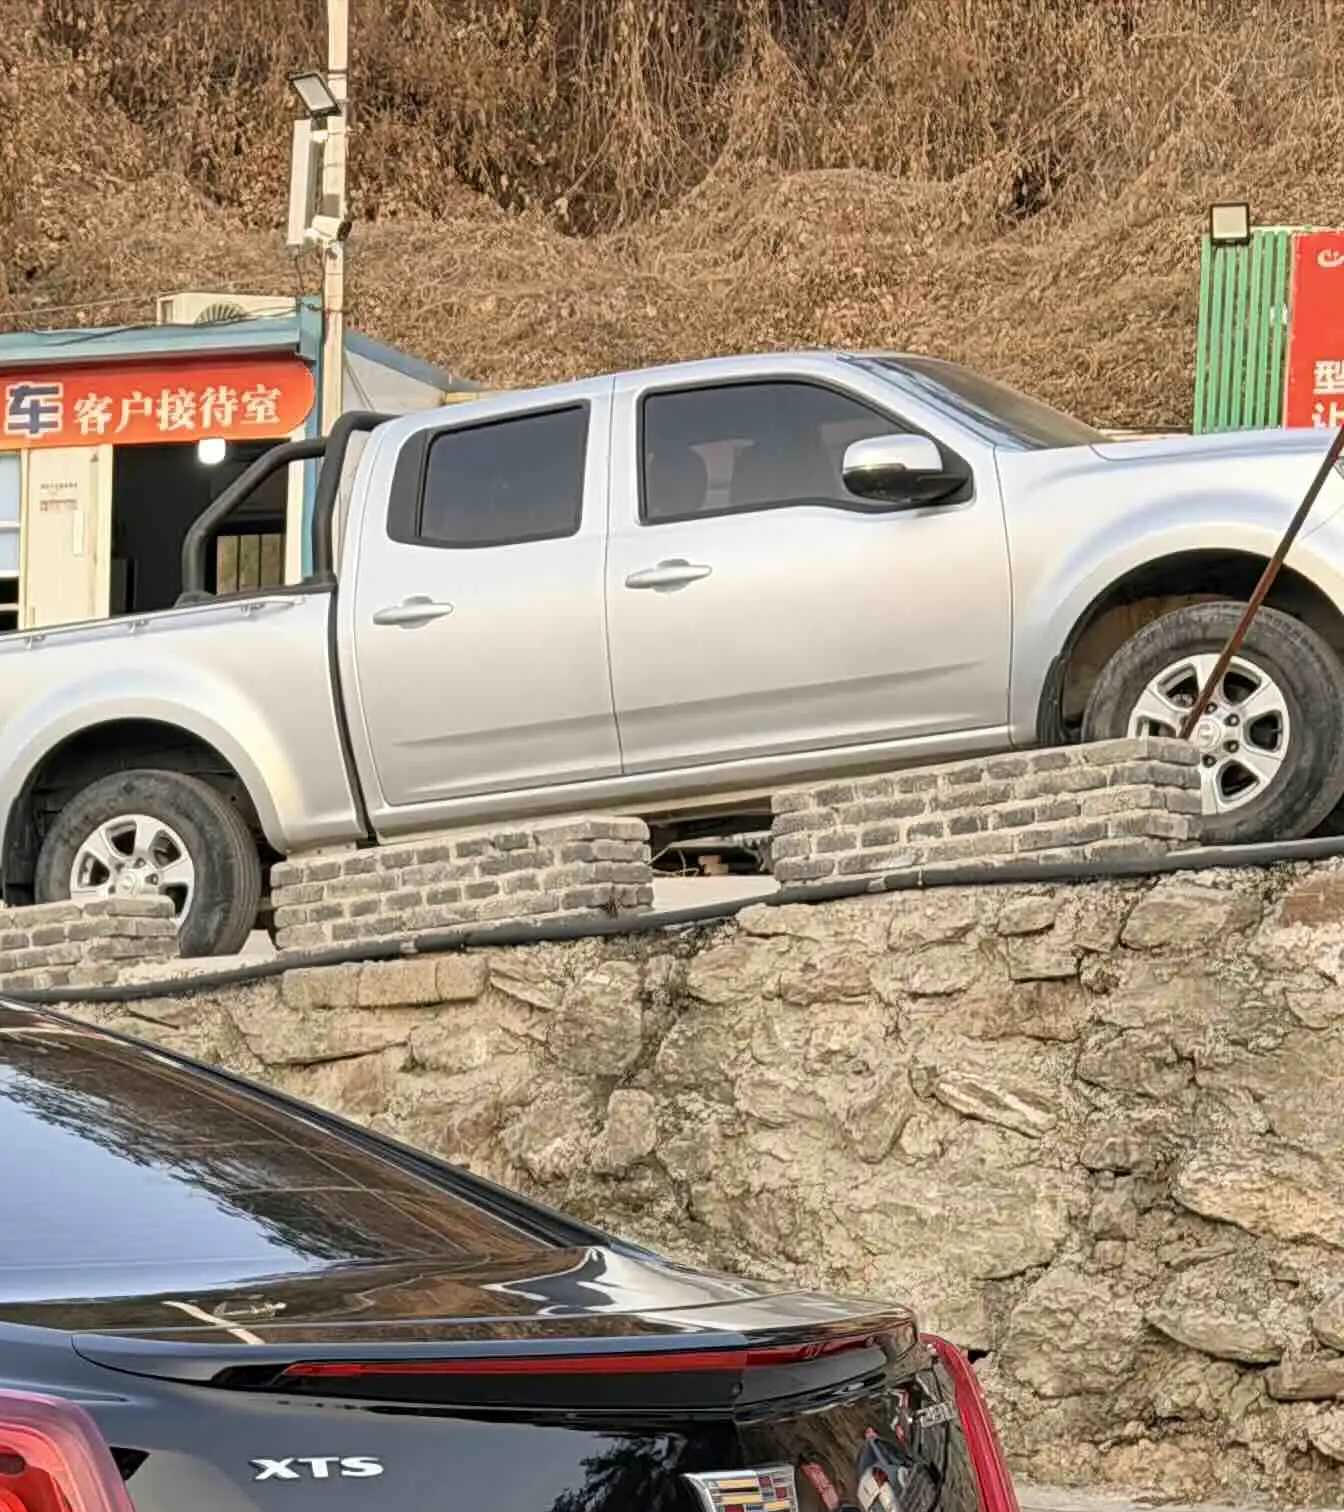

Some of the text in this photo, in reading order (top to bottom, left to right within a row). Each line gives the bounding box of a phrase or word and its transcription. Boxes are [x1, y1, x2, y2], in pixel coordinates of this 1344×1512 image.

[73, 384, 281, 436] 客户接待室
[249, 1456, 384, 1480] XTS
